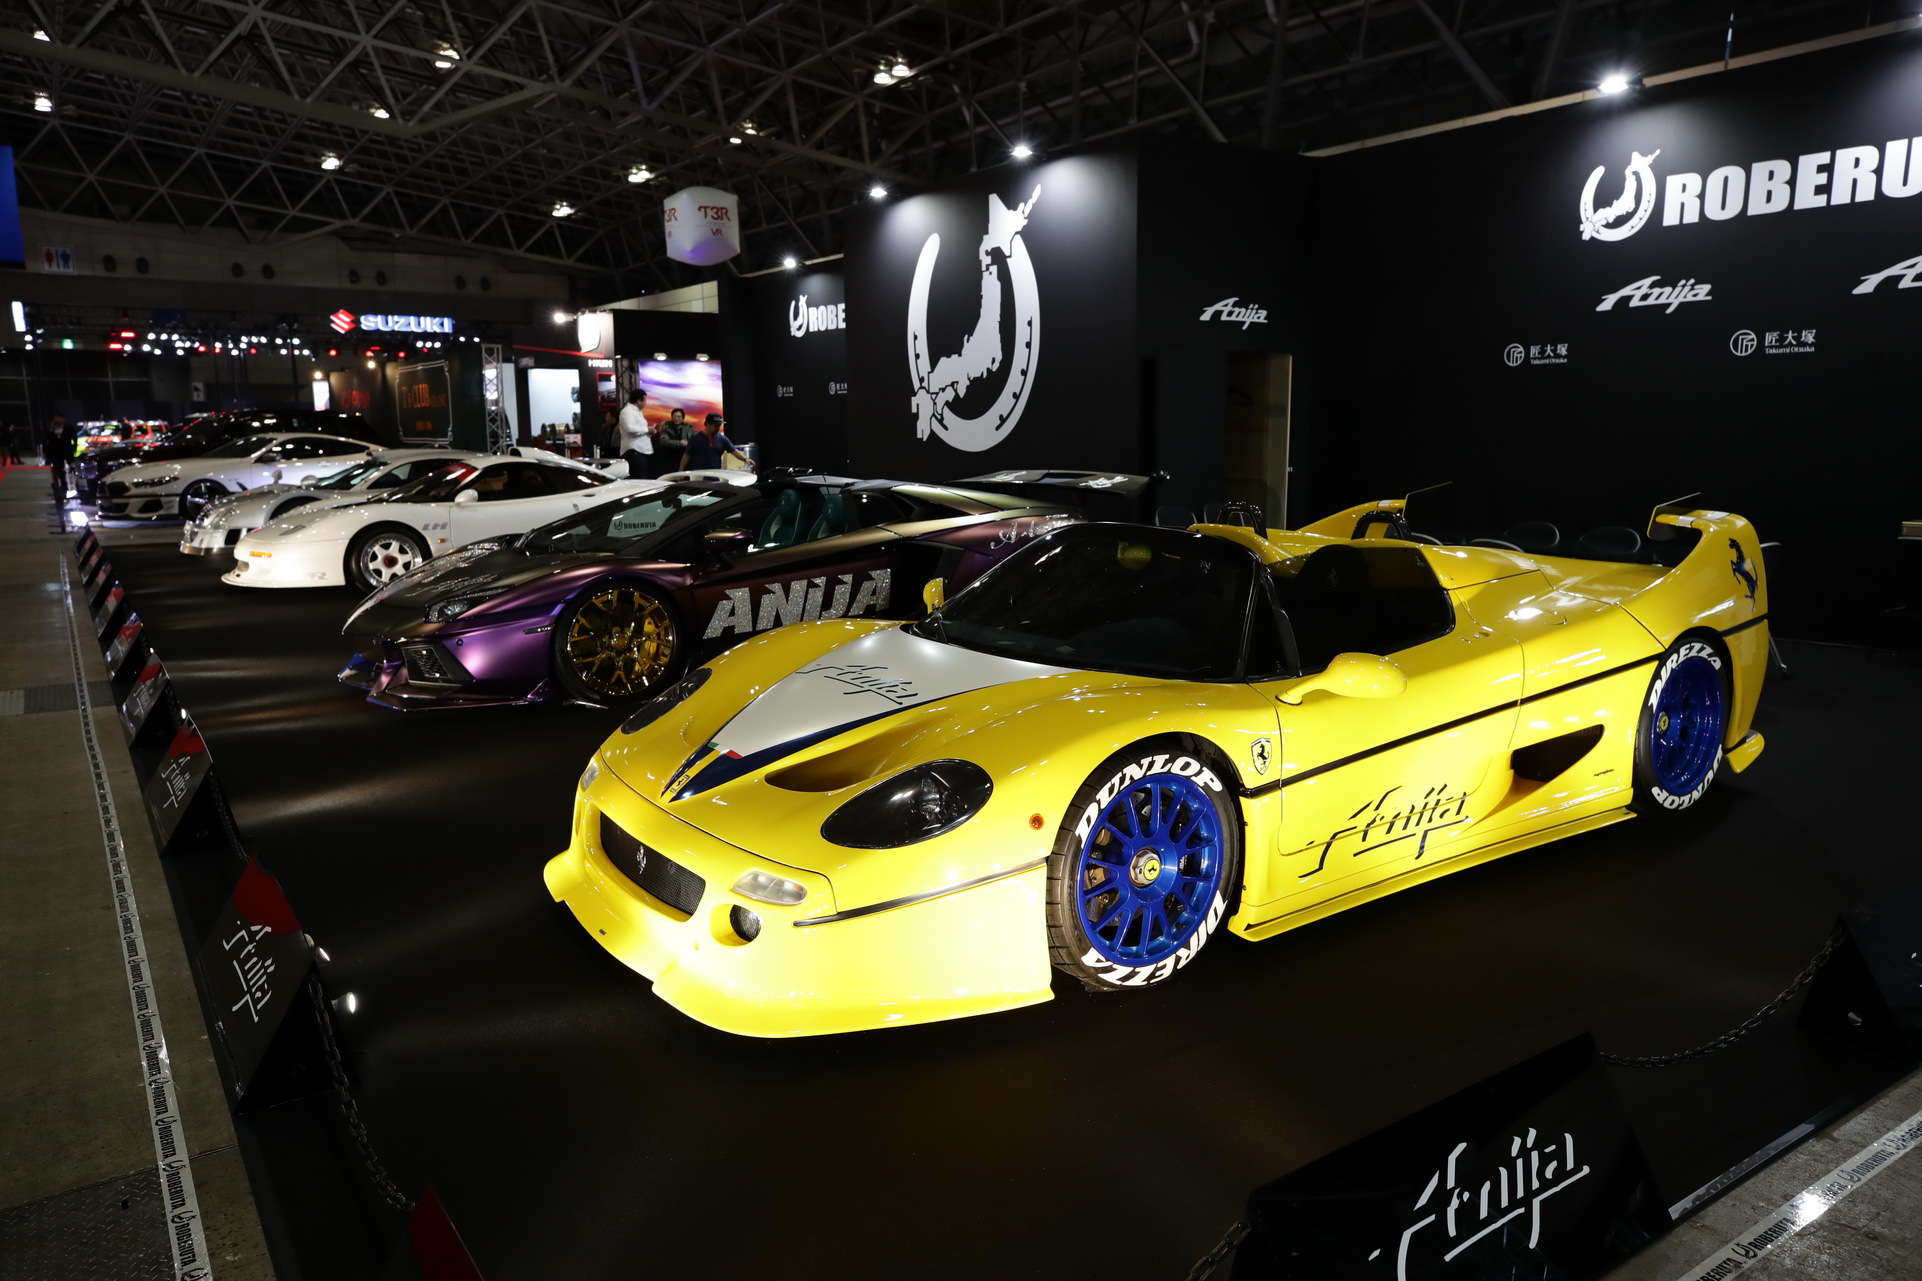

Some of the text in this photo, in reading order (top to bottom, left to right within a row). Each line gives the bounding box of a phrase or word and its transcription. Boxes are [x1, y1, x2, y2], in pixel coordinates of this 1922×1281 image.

[1662, 136, 1922, 228] ROBERU
[697, 205, 731, 222] T3R
[1199, 297, 1268, 331] Anija
[1595, 274, 1713, 315] Anija
[359, 313, 455, 334] SUZUKI
[809, 303, 846, 333] ROBE
[1764, 329, 1816, 347] 匠大塚
[1529, 343, 1568, 358] 匠大塚
[702, 568, 891, 640] ANIJA
[1647, 642, 1723, 714] DIREZZA
[1650, 743, 1724, 811] DUNLOP
[1074, 754, 1223, 849] DUNLOP
[1080, 889, 1229, 987] DIREZZA
[157, 1125, 177, 1160] ROBERUTA
[1851, 1148, 1896, 1177] ROBERUTA
[165, 1170, 187, 1210] ROBERUTA
[174, 1222, 198, 1268] ROBERUTA
